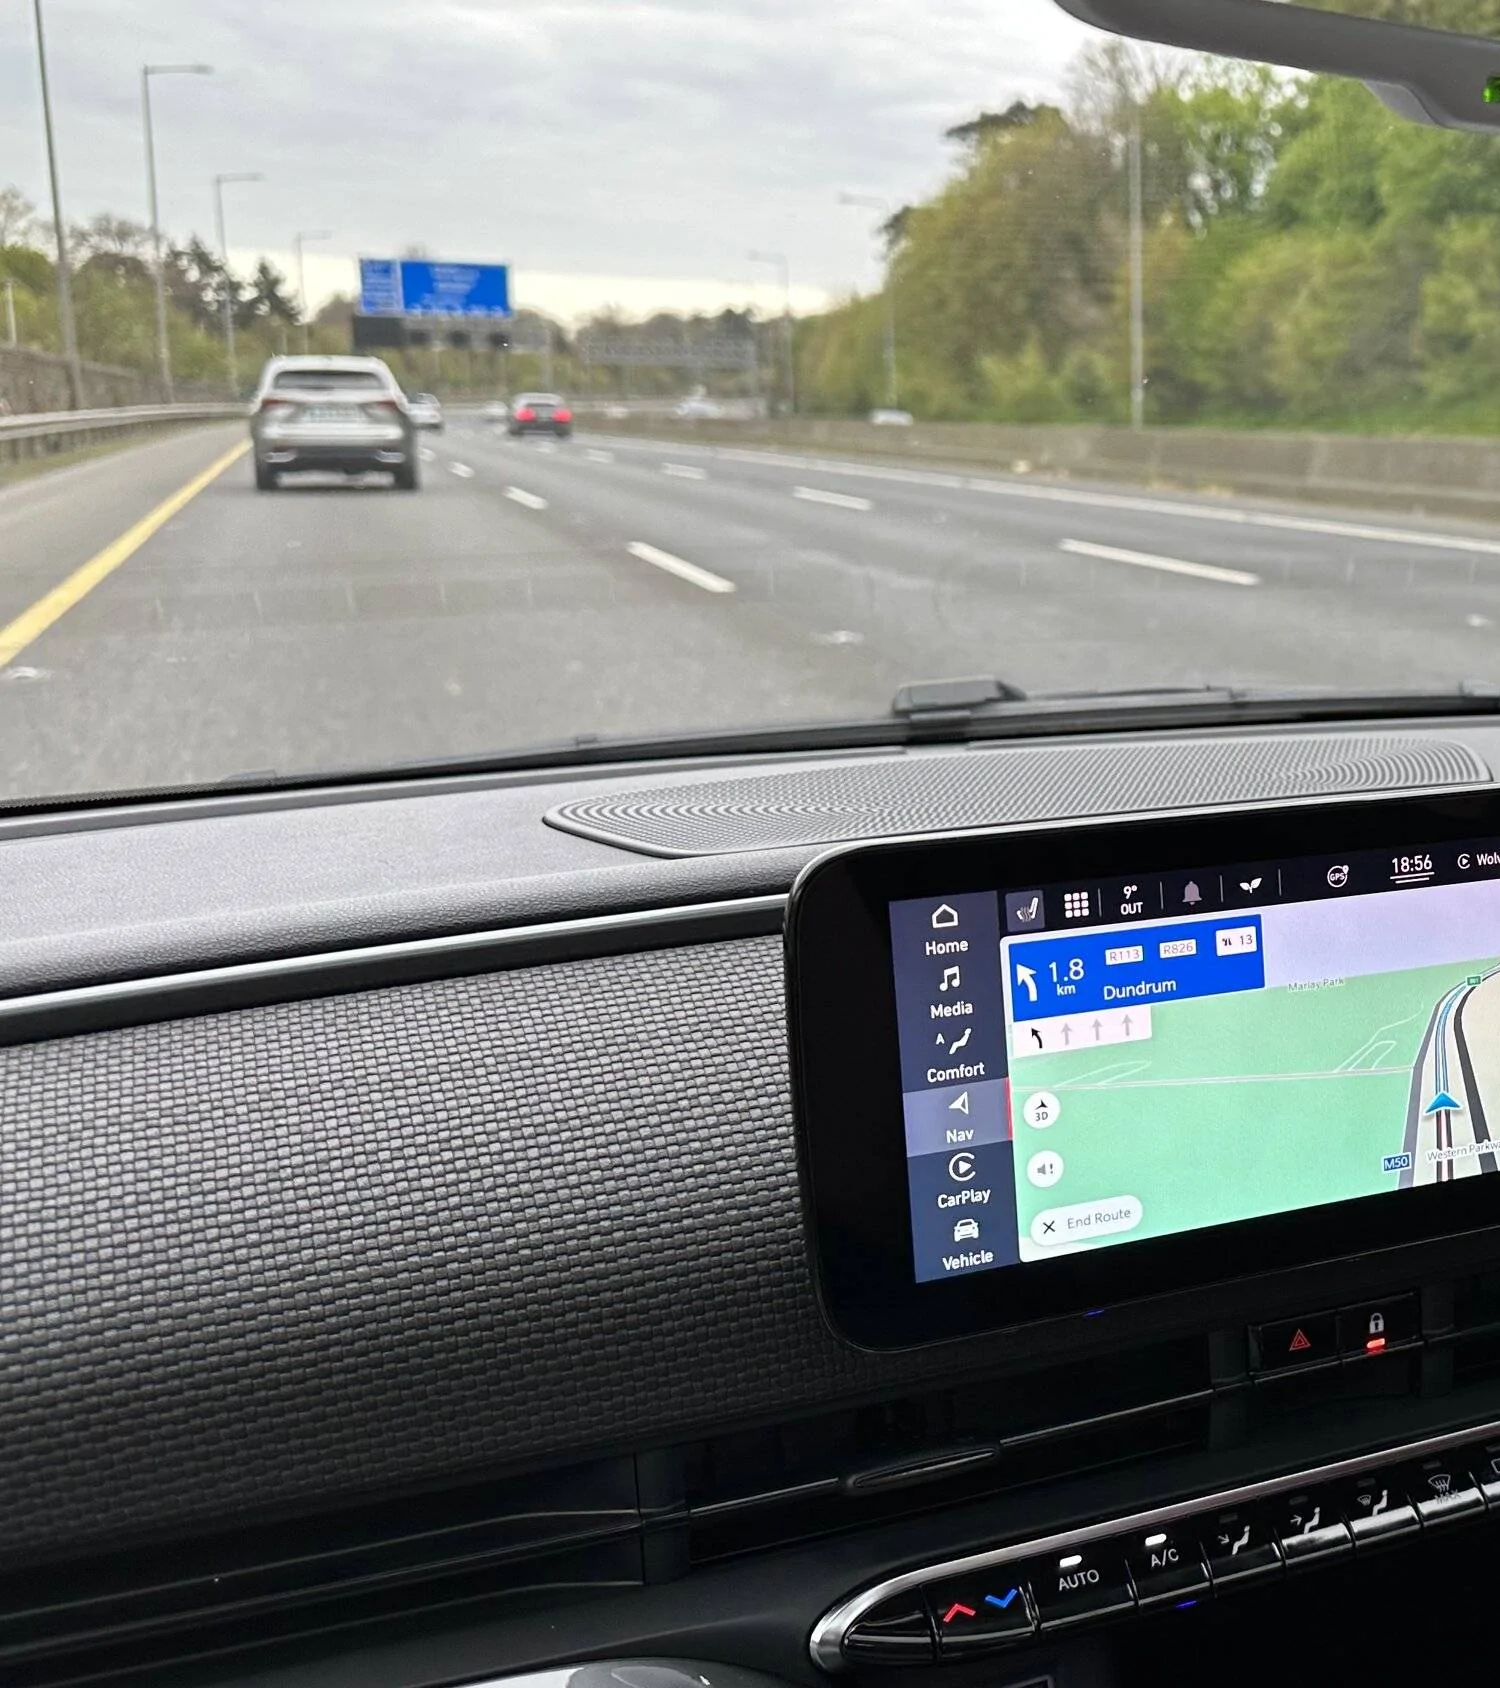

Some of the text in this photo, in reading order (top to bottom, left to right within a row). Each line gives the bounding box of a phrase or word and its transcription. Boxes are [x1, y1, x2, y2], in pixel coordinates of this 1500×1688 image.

[1391, 854, 1433, 874] 18:56
[1329, 872, 1345, 881] GPS
[1120, 901, 1144, 916] OUT
[925, 939, 969, 956] Home
[1239, 934, 1253, 945] 13
[1109, 949, 1140, 961] R113
[1163, 942, 1193, 954] R826
[1049, 958, 1085, 983] 1.8
[1056, 984, 1076, 996] km
[1103, 979, 1177, 1001] Dundrum
[1323, 977, 1344, 987] Park
[930, 1001, 974, 1019] Media
[935, 1033, 945, 1045] A
[926, 1062, 986, 1083] Comfort
[1035, 1111, 1049, 1122] 3D
[946, 1128, 975, 1144] Nav
[1427, 1147, 1468, 1162] Western
[1383, 1156, 1409, 1170] M50
[937, 1188, 991, 1209] CarPlay
[1067, 1209, 1132, 1230] End Route
[942, 1250, 994, 1271] Vehicle
[1150, 1548, 1179, 1567] A/C
[1058, 1569, 1100, 1591] AUTO
